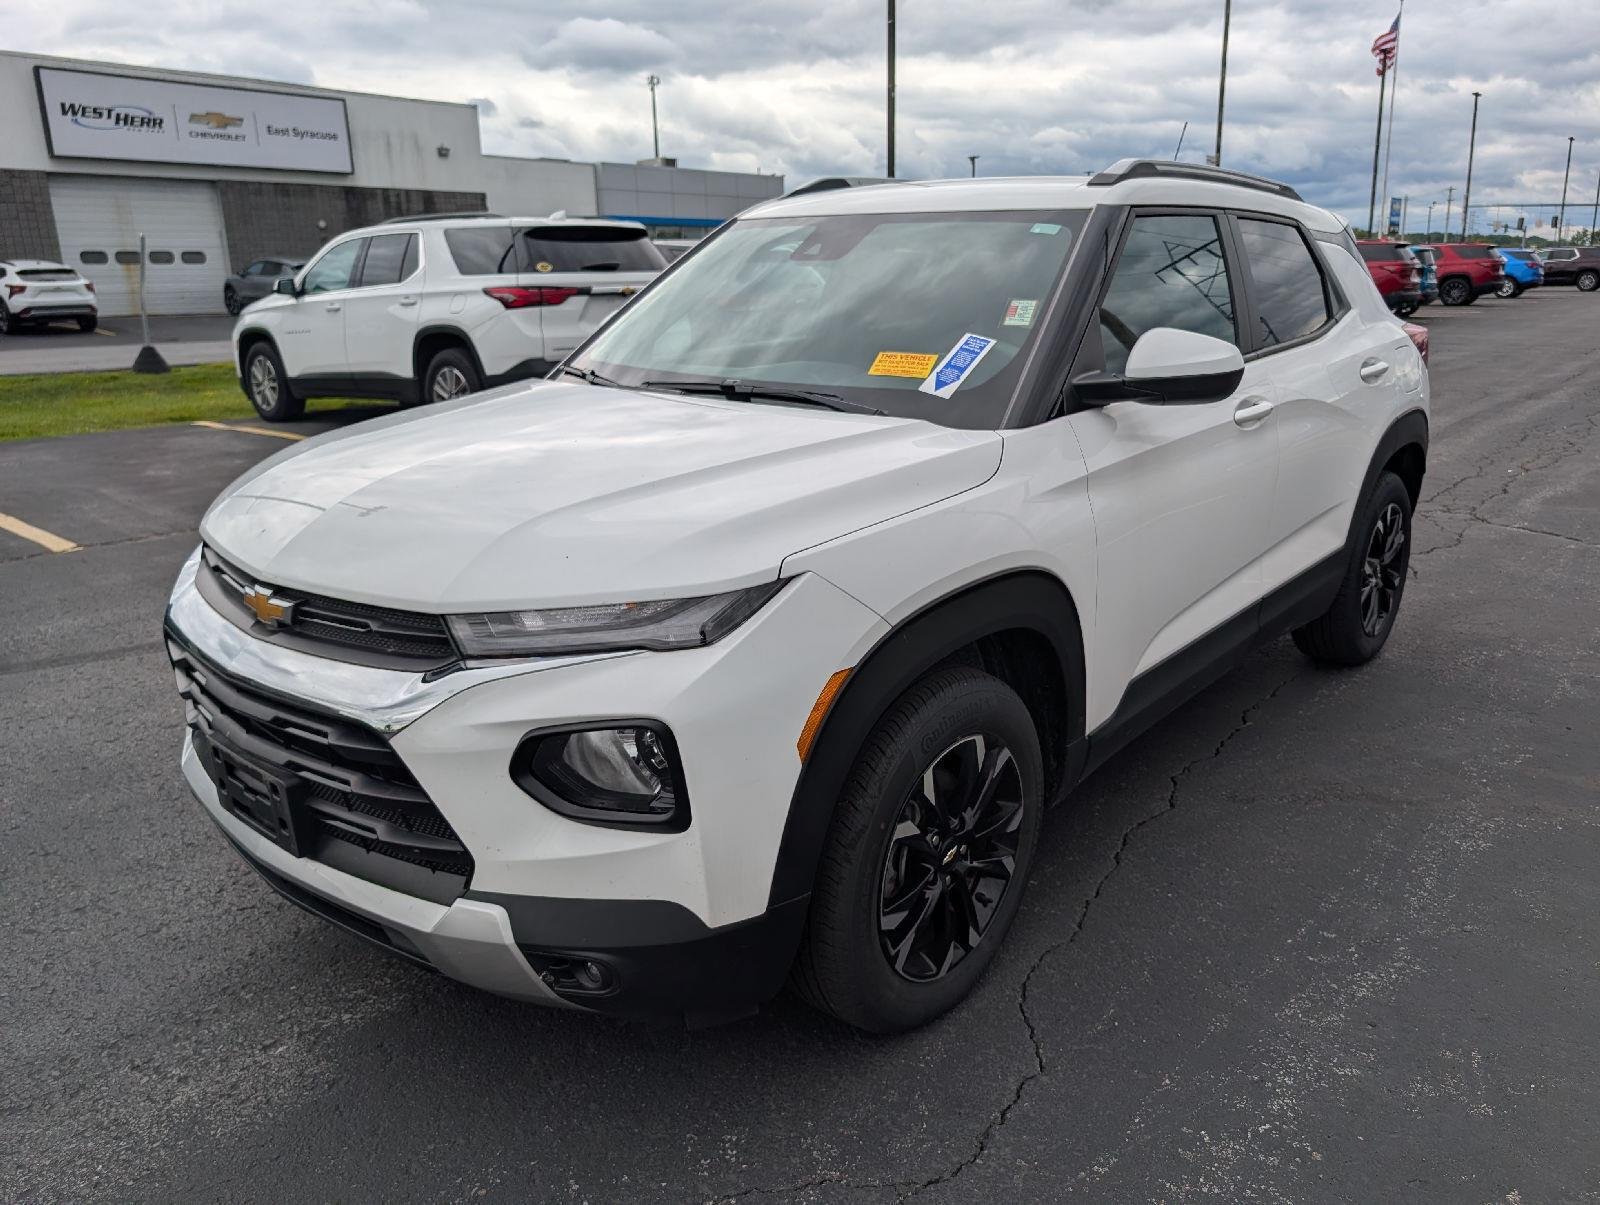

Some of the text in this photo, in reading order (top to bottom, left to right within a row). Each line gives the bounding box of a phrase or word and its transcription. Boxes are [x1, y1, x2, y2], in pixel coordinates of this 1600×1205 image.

[60, 102, 164, 129] WEST HERR
[188, 130, 246, 142] CHEVROLET
[267, 125, 338, 141] East Syracuse
